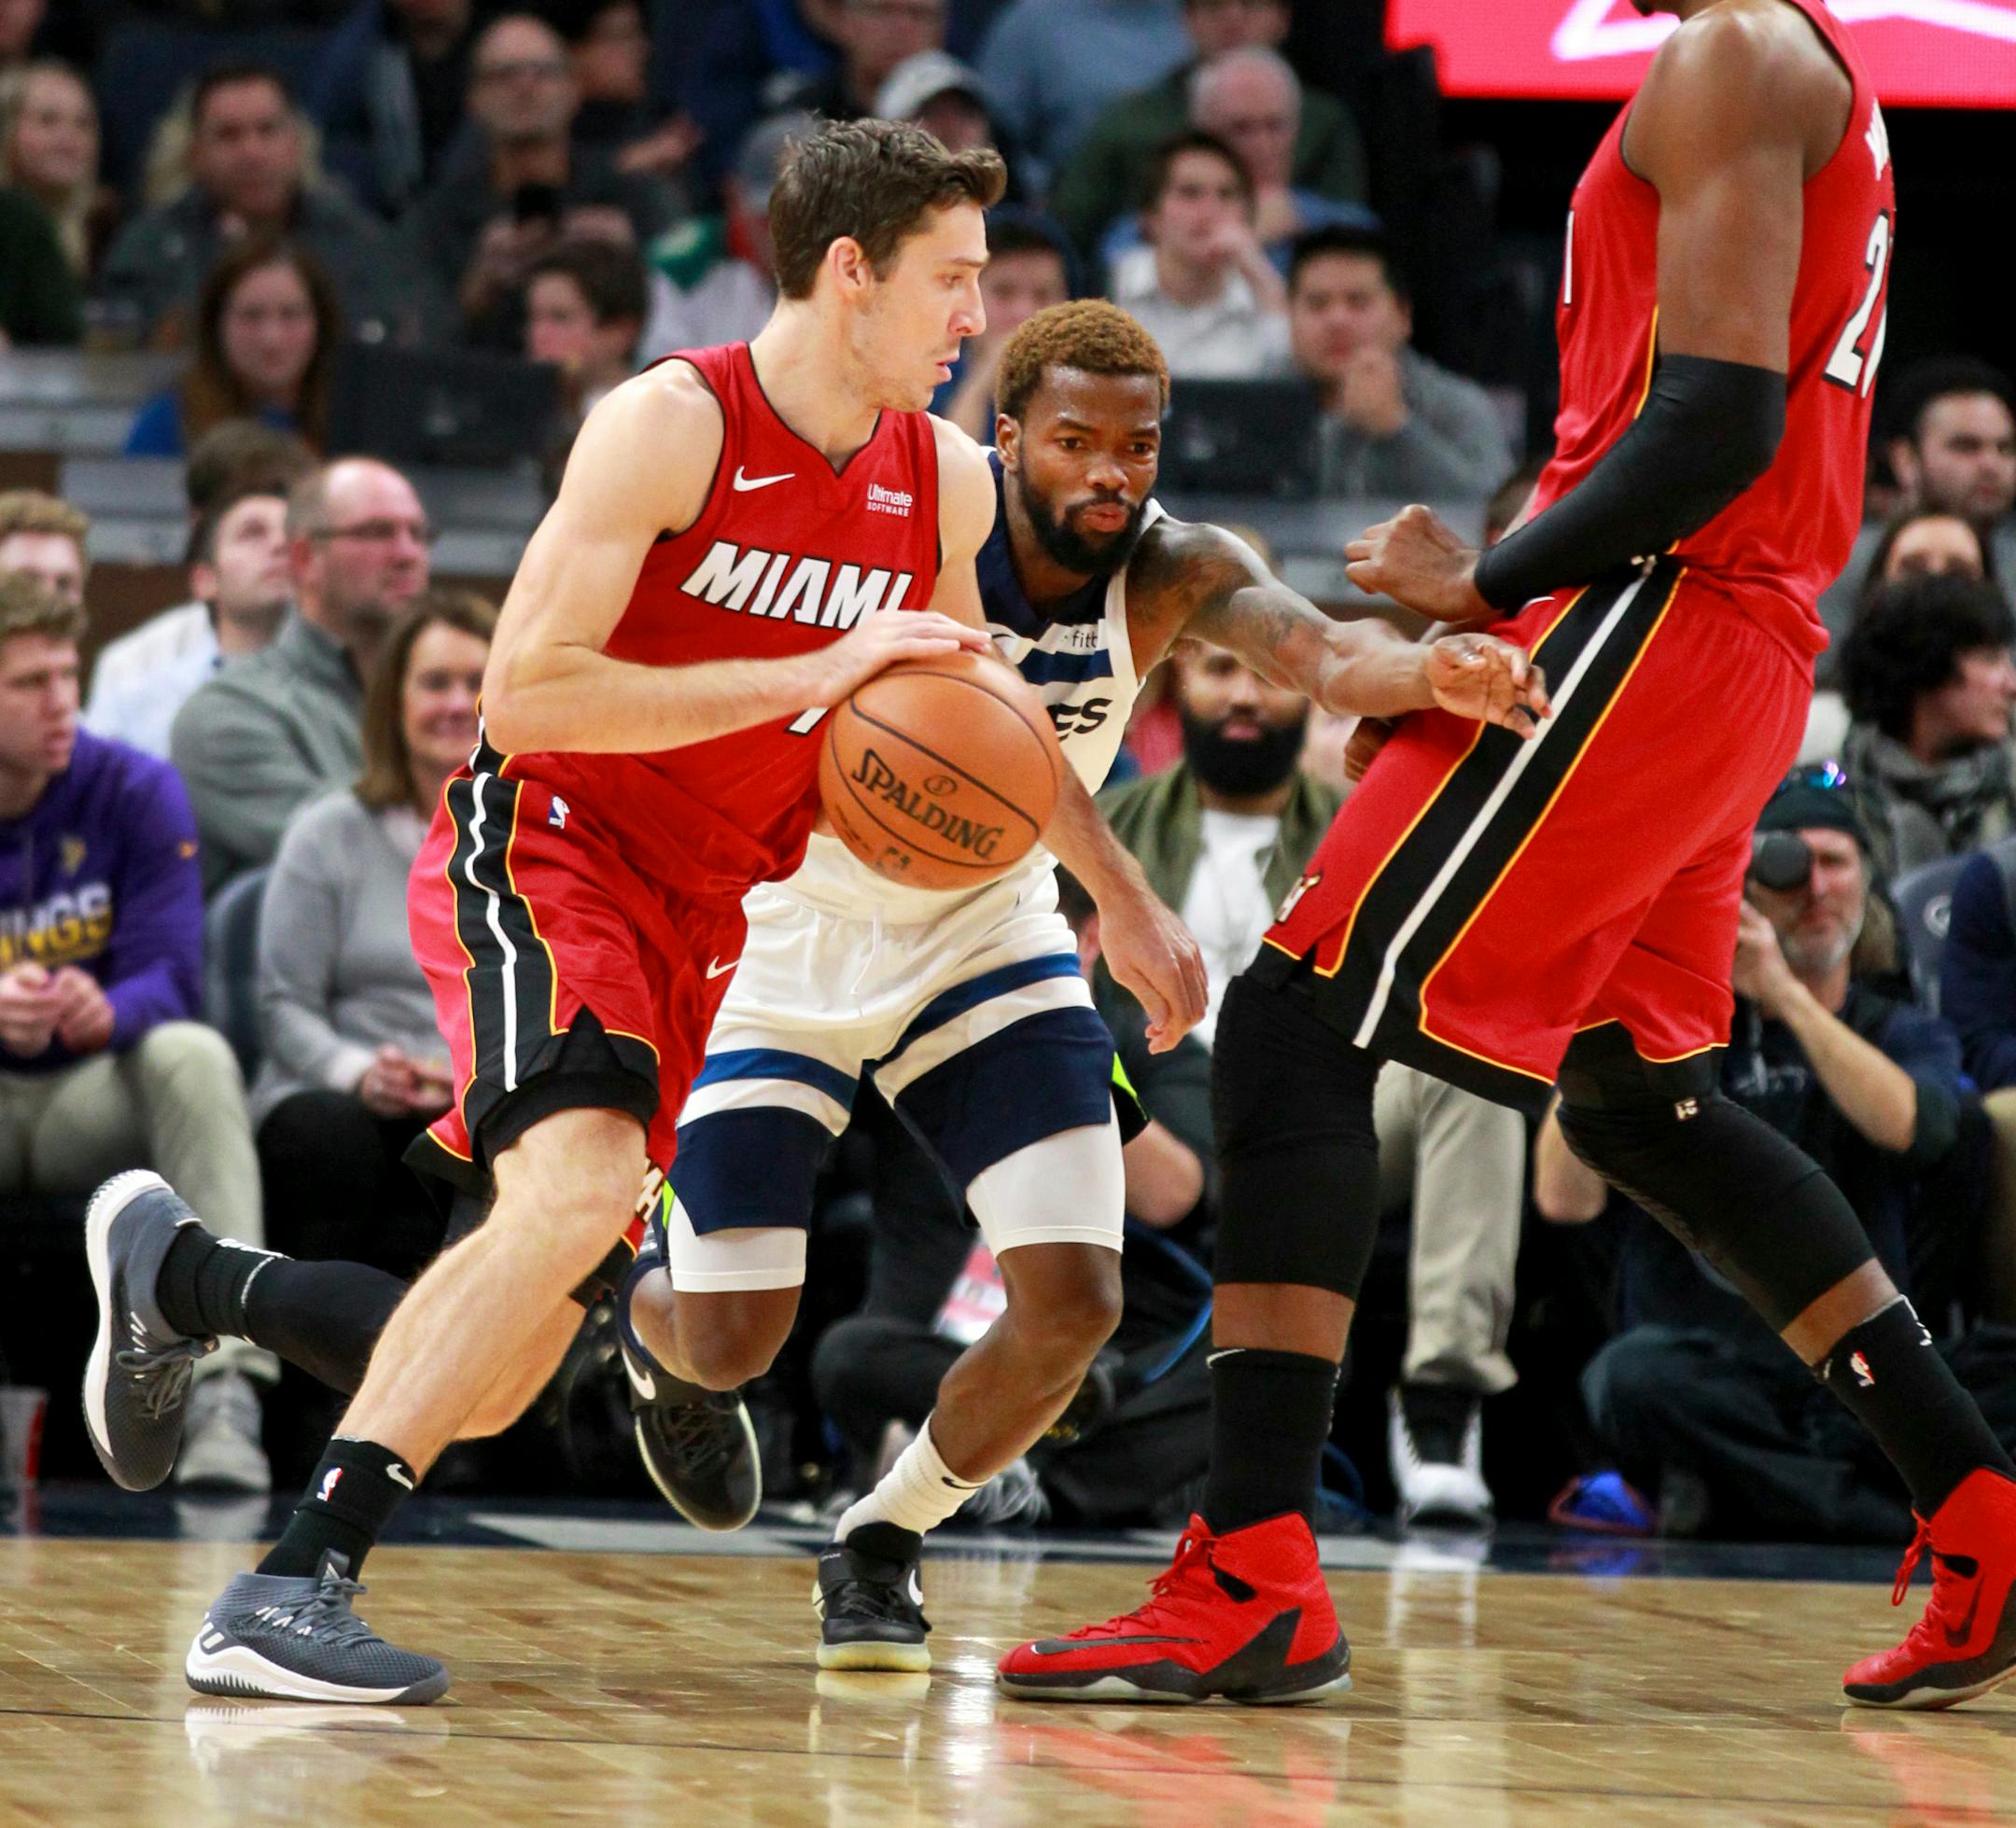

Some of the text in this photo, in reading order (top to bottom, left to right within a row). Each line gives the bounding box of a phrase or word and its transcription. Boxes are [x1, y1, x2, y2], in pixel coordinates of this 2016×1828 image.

[867, 483, 913, 507] Ultimate
[867, 501, 910, 517] SOFTWARE
[679, 539, 914, 630] MIAMI
[851, 748, 1003, 860] SPALDING
